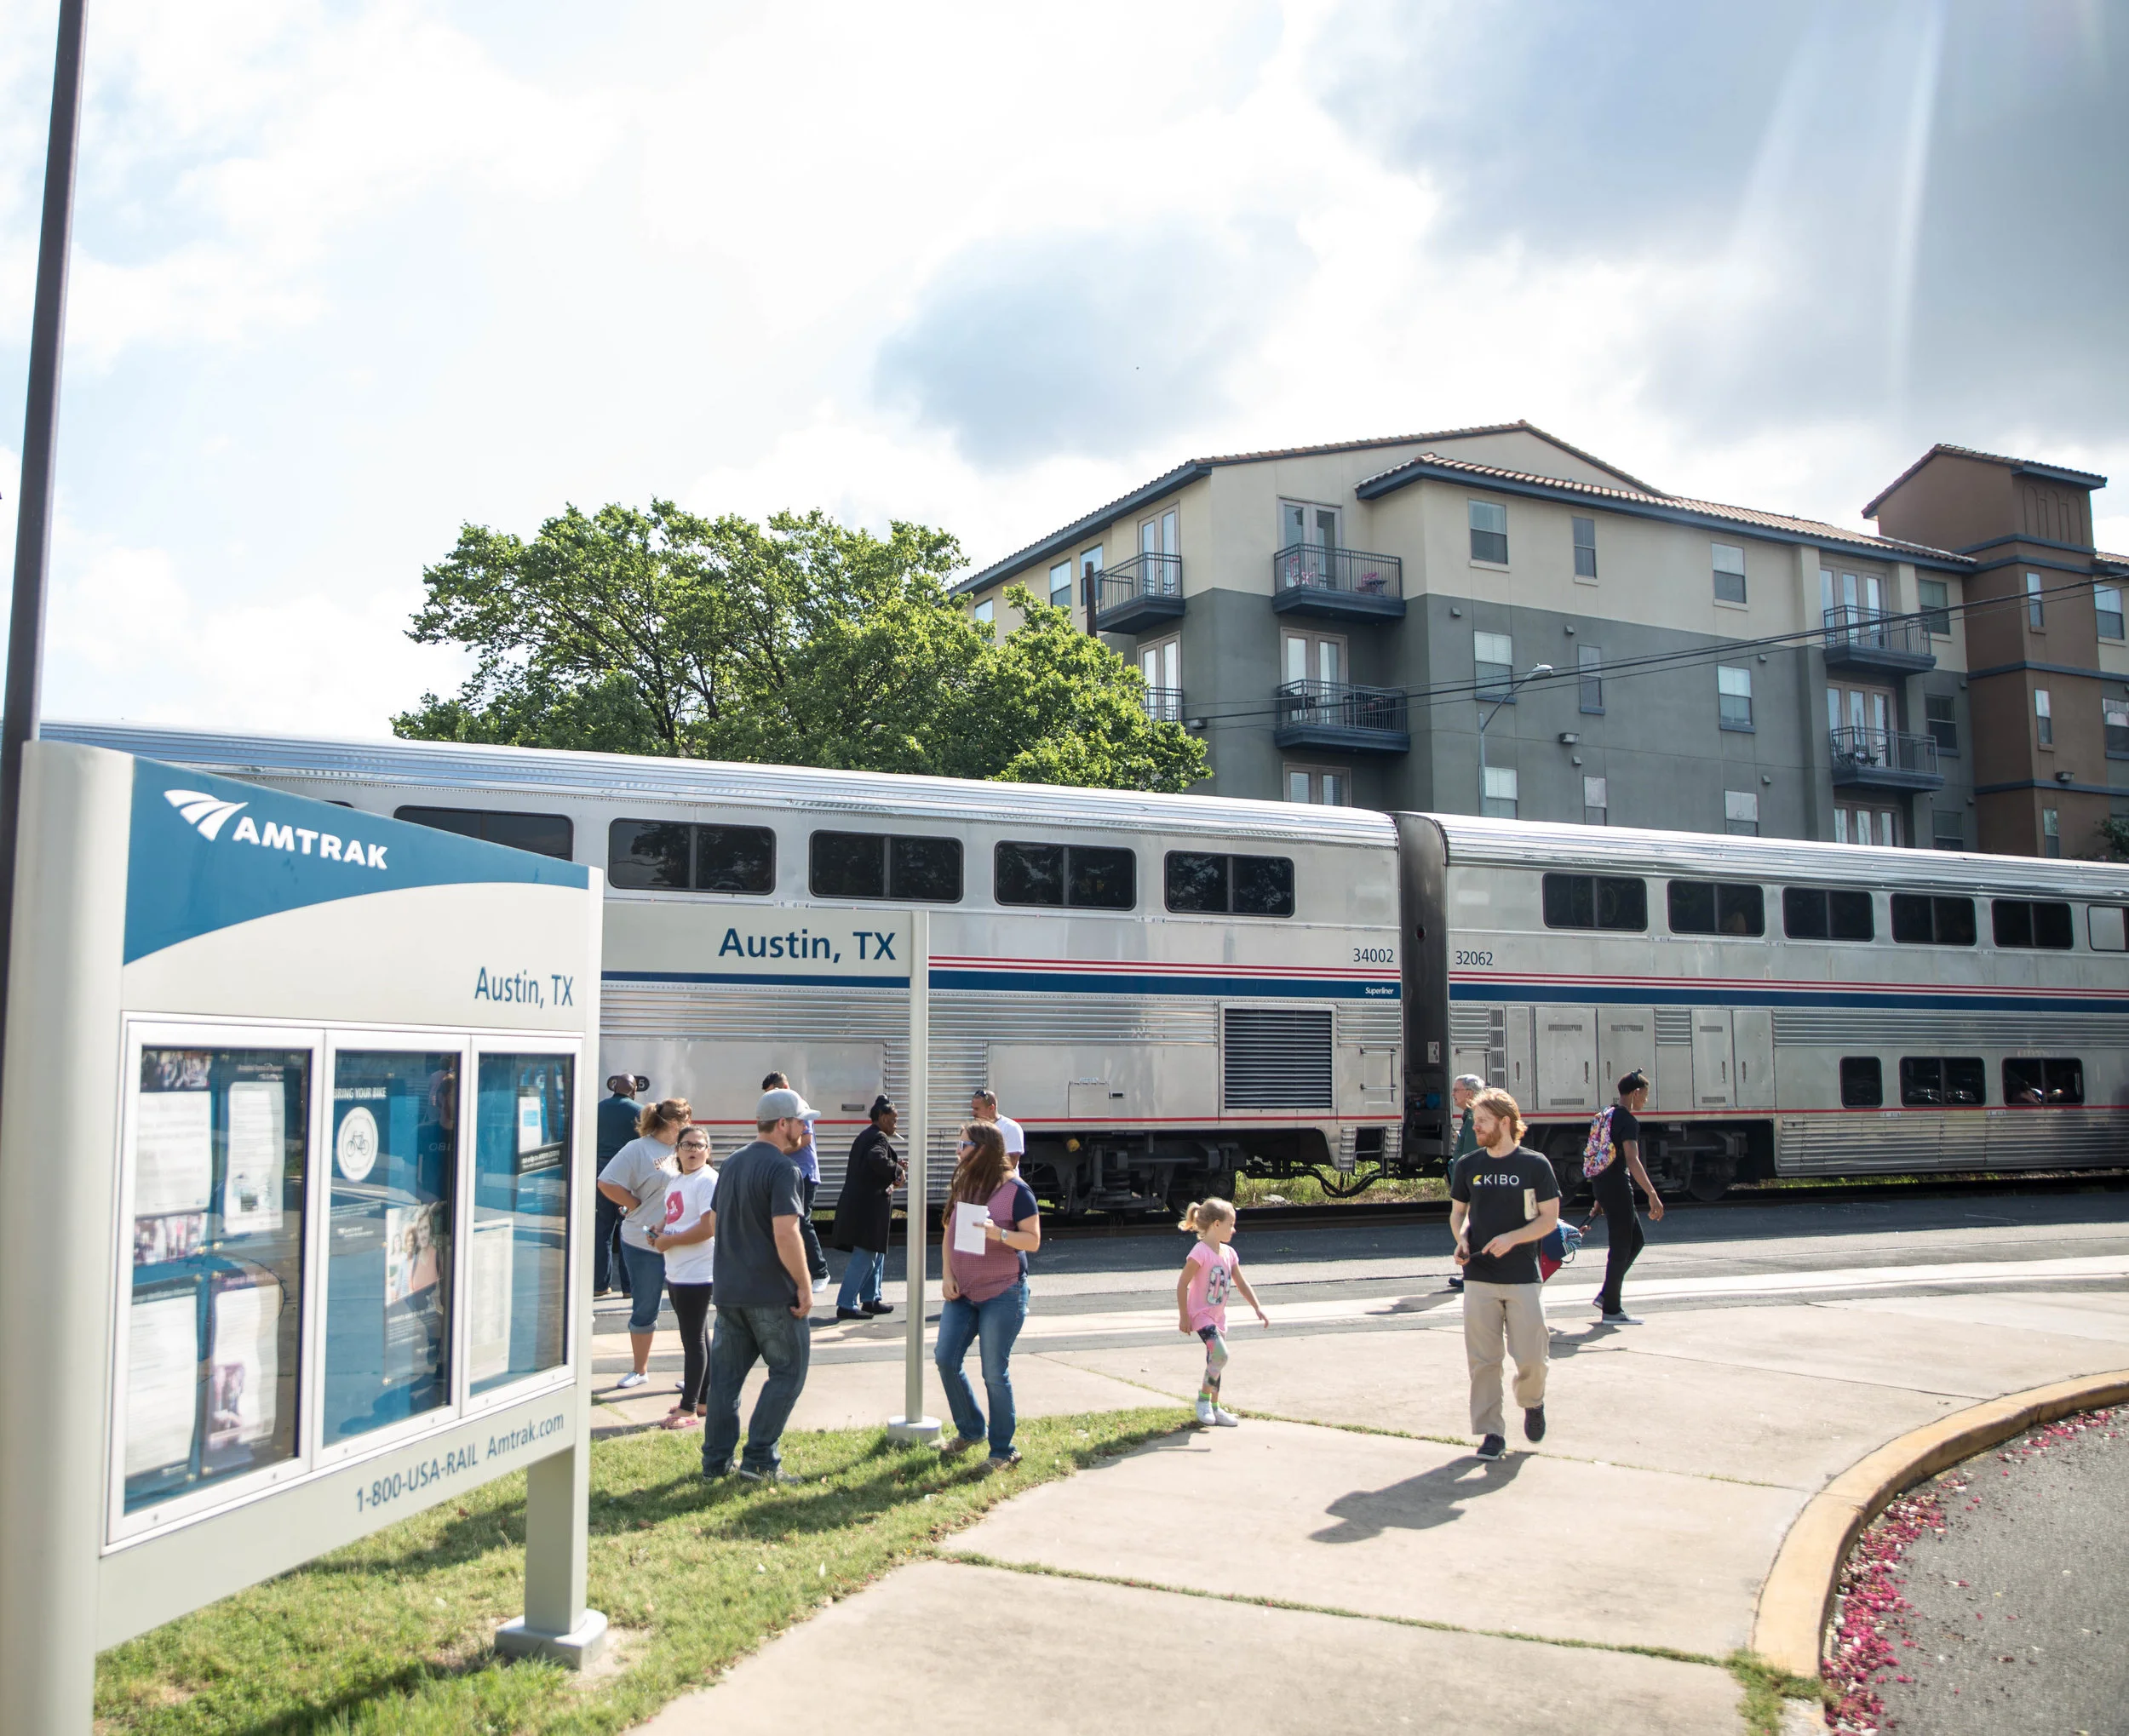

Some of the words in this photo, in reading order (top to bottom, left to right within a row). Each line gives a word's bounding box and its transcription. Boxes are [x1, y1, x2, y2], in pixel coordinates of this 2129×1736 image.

[232, 816, 389, 871] AMTRAK
[719, 927, 841, 964] Austin,
[852, 931, 897, 960] TX
[1352, 948, 1395, 963] 34002
[1455, 950, 1494, 966] 32062
[474, 966, 544, 1009] Austin,
[551, 974, 574, 1006] TX
[1364, 986, 1394, 995] Superliner
[354, 1086, 372, 1098] YOUR
[372, 1086, 387, 1097] BIKE
[1483, 1174, 1520, 1185] KIBO
[356, 1443, 479, 1513] 1-800-USA-RAIL
[485, 1412, 565, 1460] Amtrak.com
